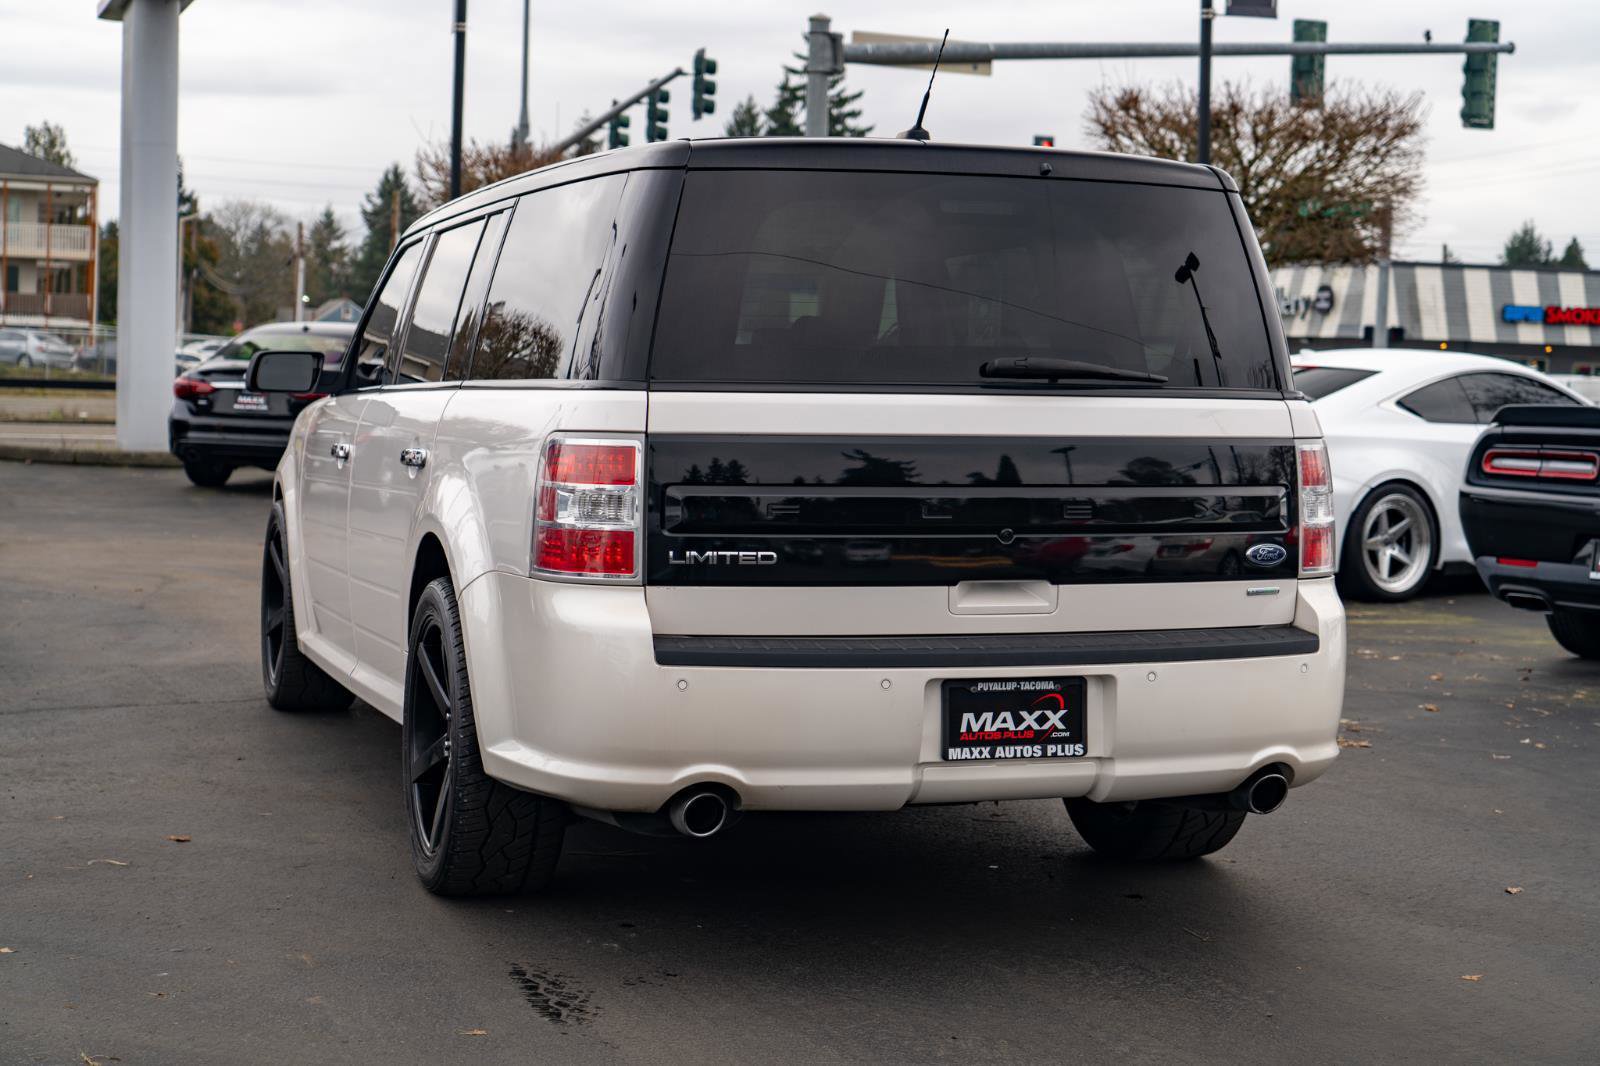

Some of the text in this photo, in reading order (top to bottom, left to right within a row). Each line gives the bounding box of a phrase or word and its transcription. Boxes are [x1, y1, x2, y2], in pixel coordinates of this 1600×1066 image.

[669, 550, 777, 565] LIMITED
[1257, 547, 1279, 560] Ford
[960, 710, 1067, 732] MAXX
[960, 730, 1034, 741] AUTOS PLUS
[948, 743, 1084, 760] MAXX AUTOS PLUS
